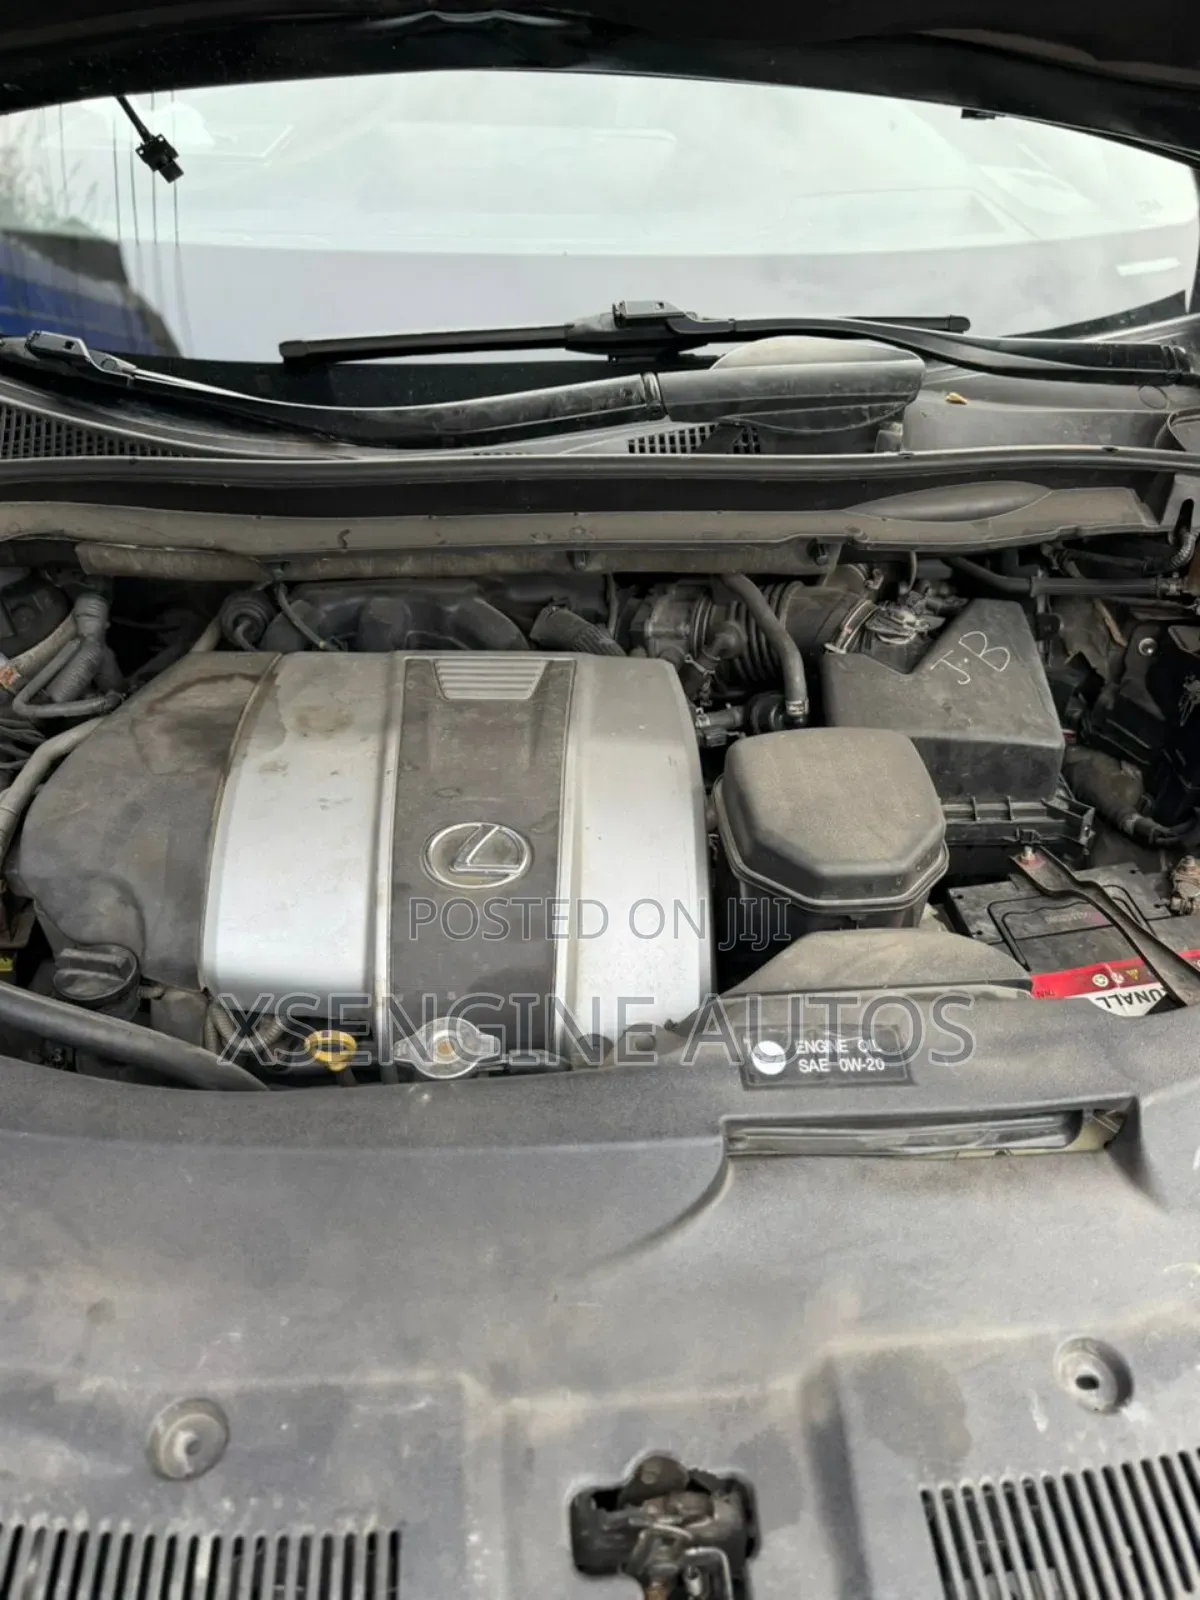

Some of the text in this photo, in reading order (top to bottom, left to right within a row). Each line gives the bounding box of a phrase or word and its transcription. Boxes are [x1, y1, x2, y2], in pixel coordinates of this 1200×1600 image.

[795, 1038, 882, 1054] ENGINE OIL
[798, 1057, 885, 1073] SAE 0W-20
